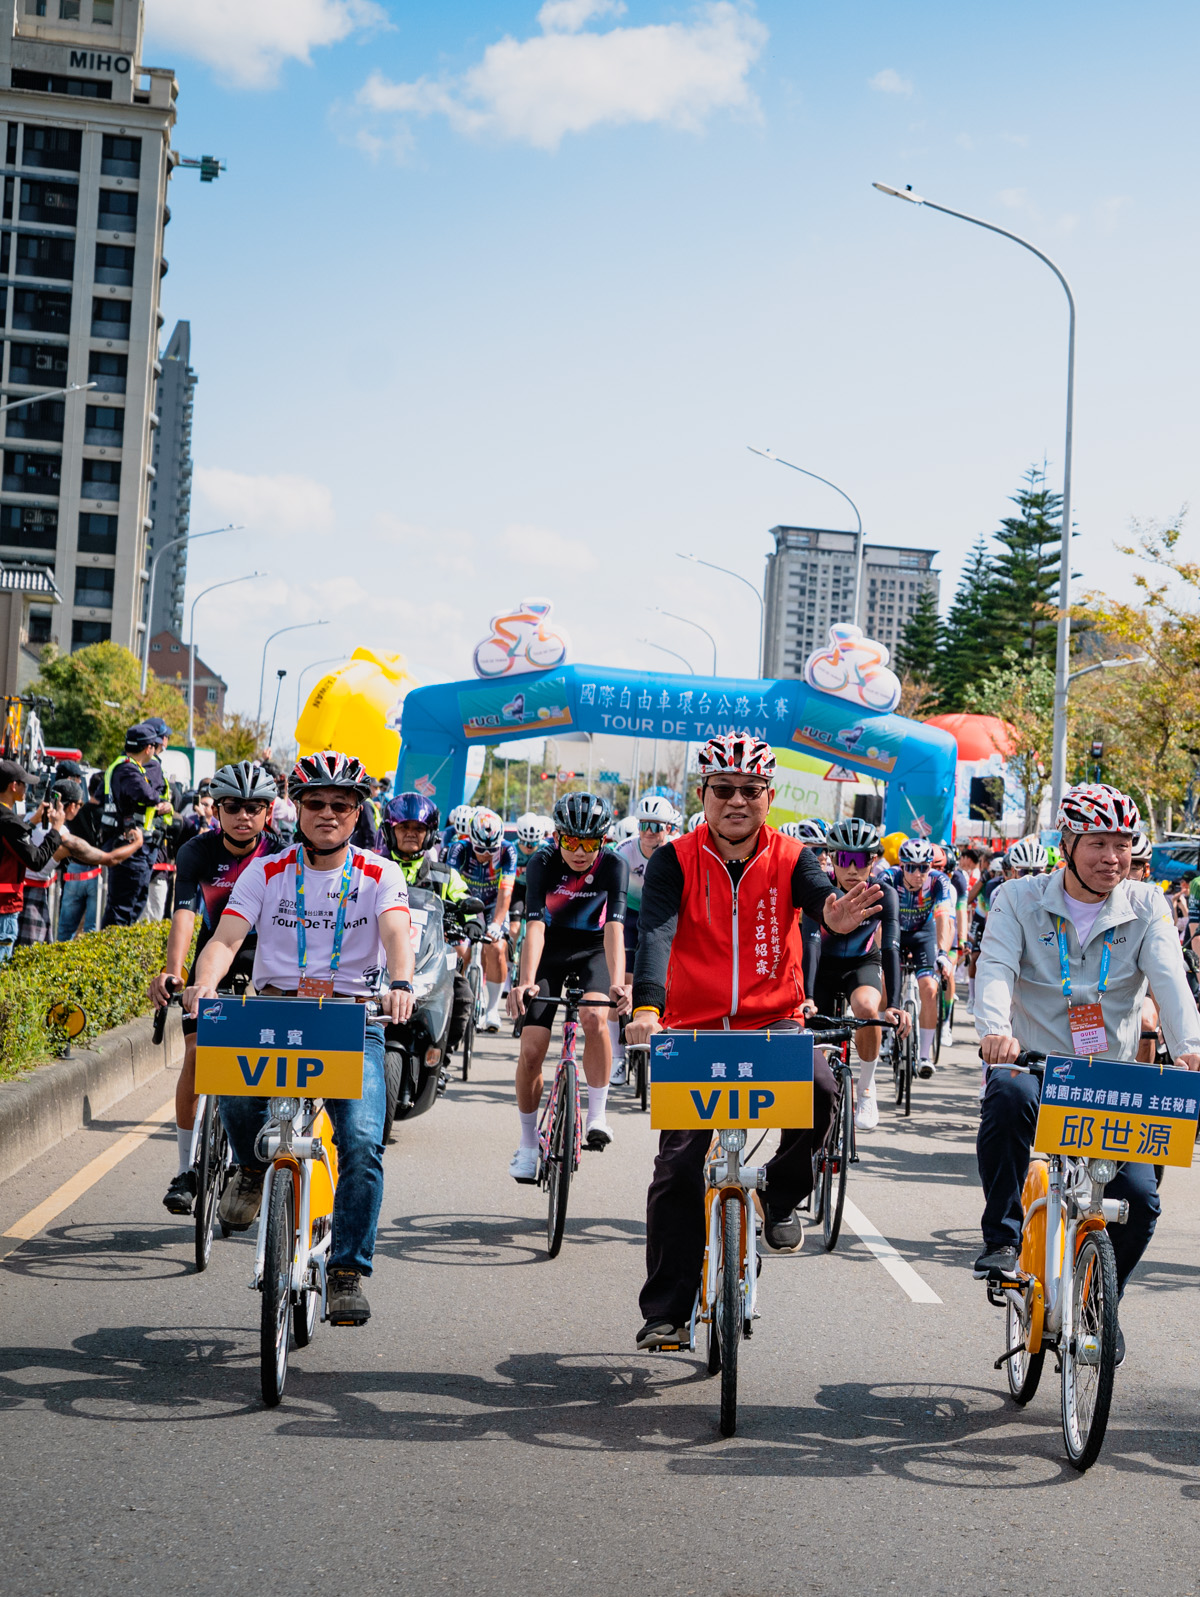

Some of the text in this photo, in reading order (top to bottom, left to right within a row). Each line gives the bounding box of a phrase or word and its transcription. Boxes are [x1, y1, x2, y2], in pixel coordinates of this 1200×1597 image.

[70, 50, 131, 74] MIHO
[579, 683, 790, 722] 國際自由車環台公路大賽
[475, 715, 500, 726] UCI
[601, 714, 767, 741] TOUR DE TAIWAN
[808, 727, 832, 742] UCI
[272, 915, 368, 930] Tour De Tawan
[1113, 936, 1127, 945] UCI
[236, 1055, 324, 1088] VIP
[689, 1089, 775, 1120] VIP
[1045, 1083, 1197, 1114] 桃園市政府體育局 主任秘書
[1058, 1114, 1172, 1157] 邱世源
